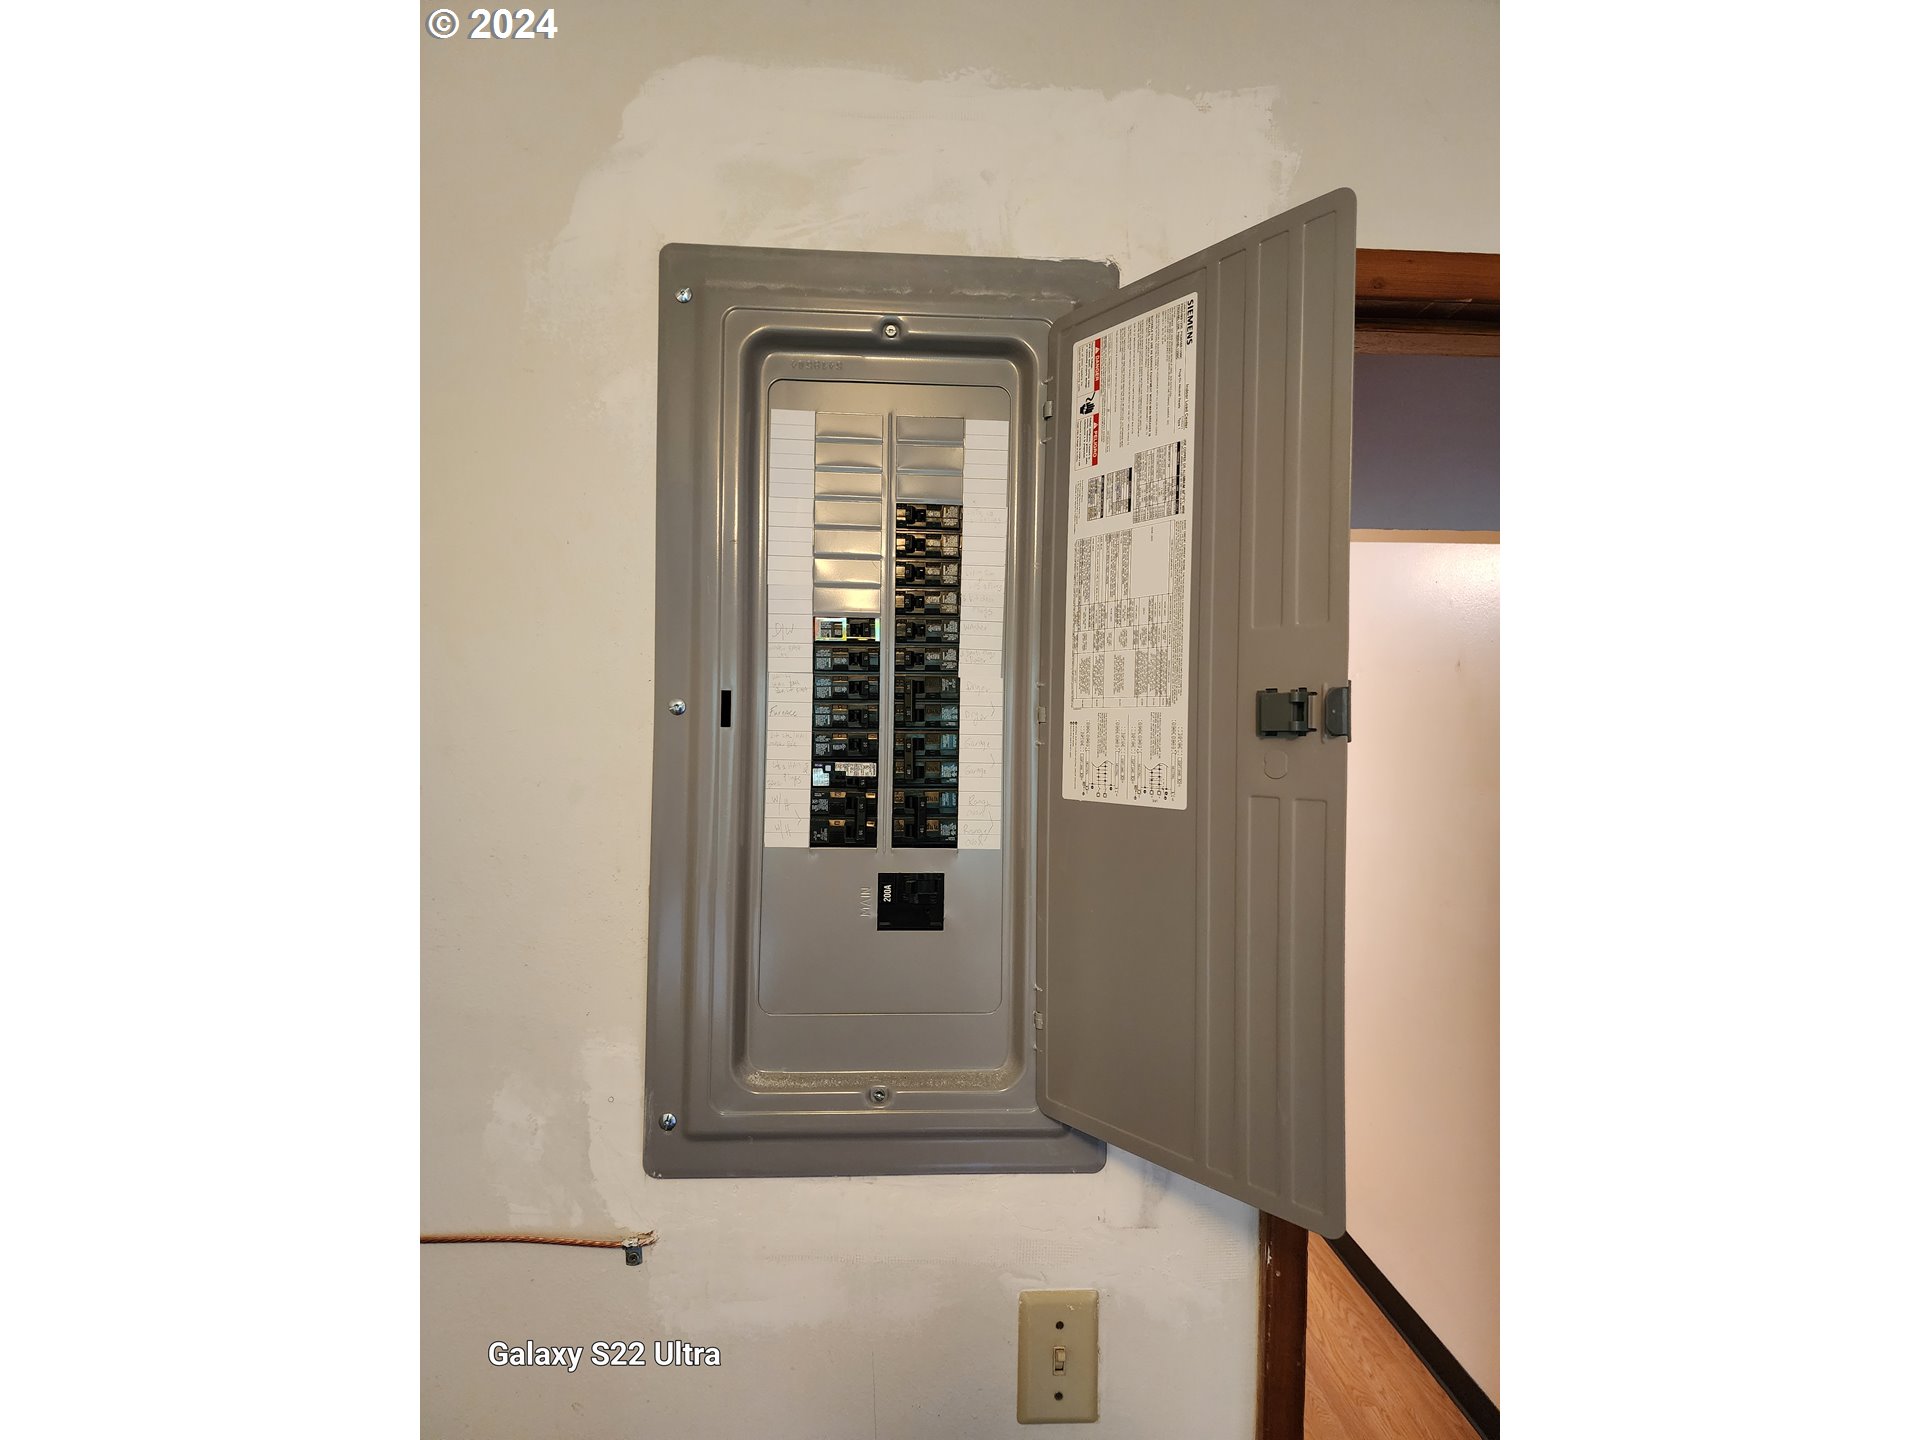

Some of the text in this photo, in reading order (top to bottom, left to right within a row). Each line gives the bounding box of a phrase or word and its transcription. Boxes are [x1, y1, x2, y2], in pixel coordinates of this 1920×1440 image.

[769, 704, 797, 717] Furnace
[860, 887, 871, 918] MAIN
[883, 885, 892, 903] 200A
